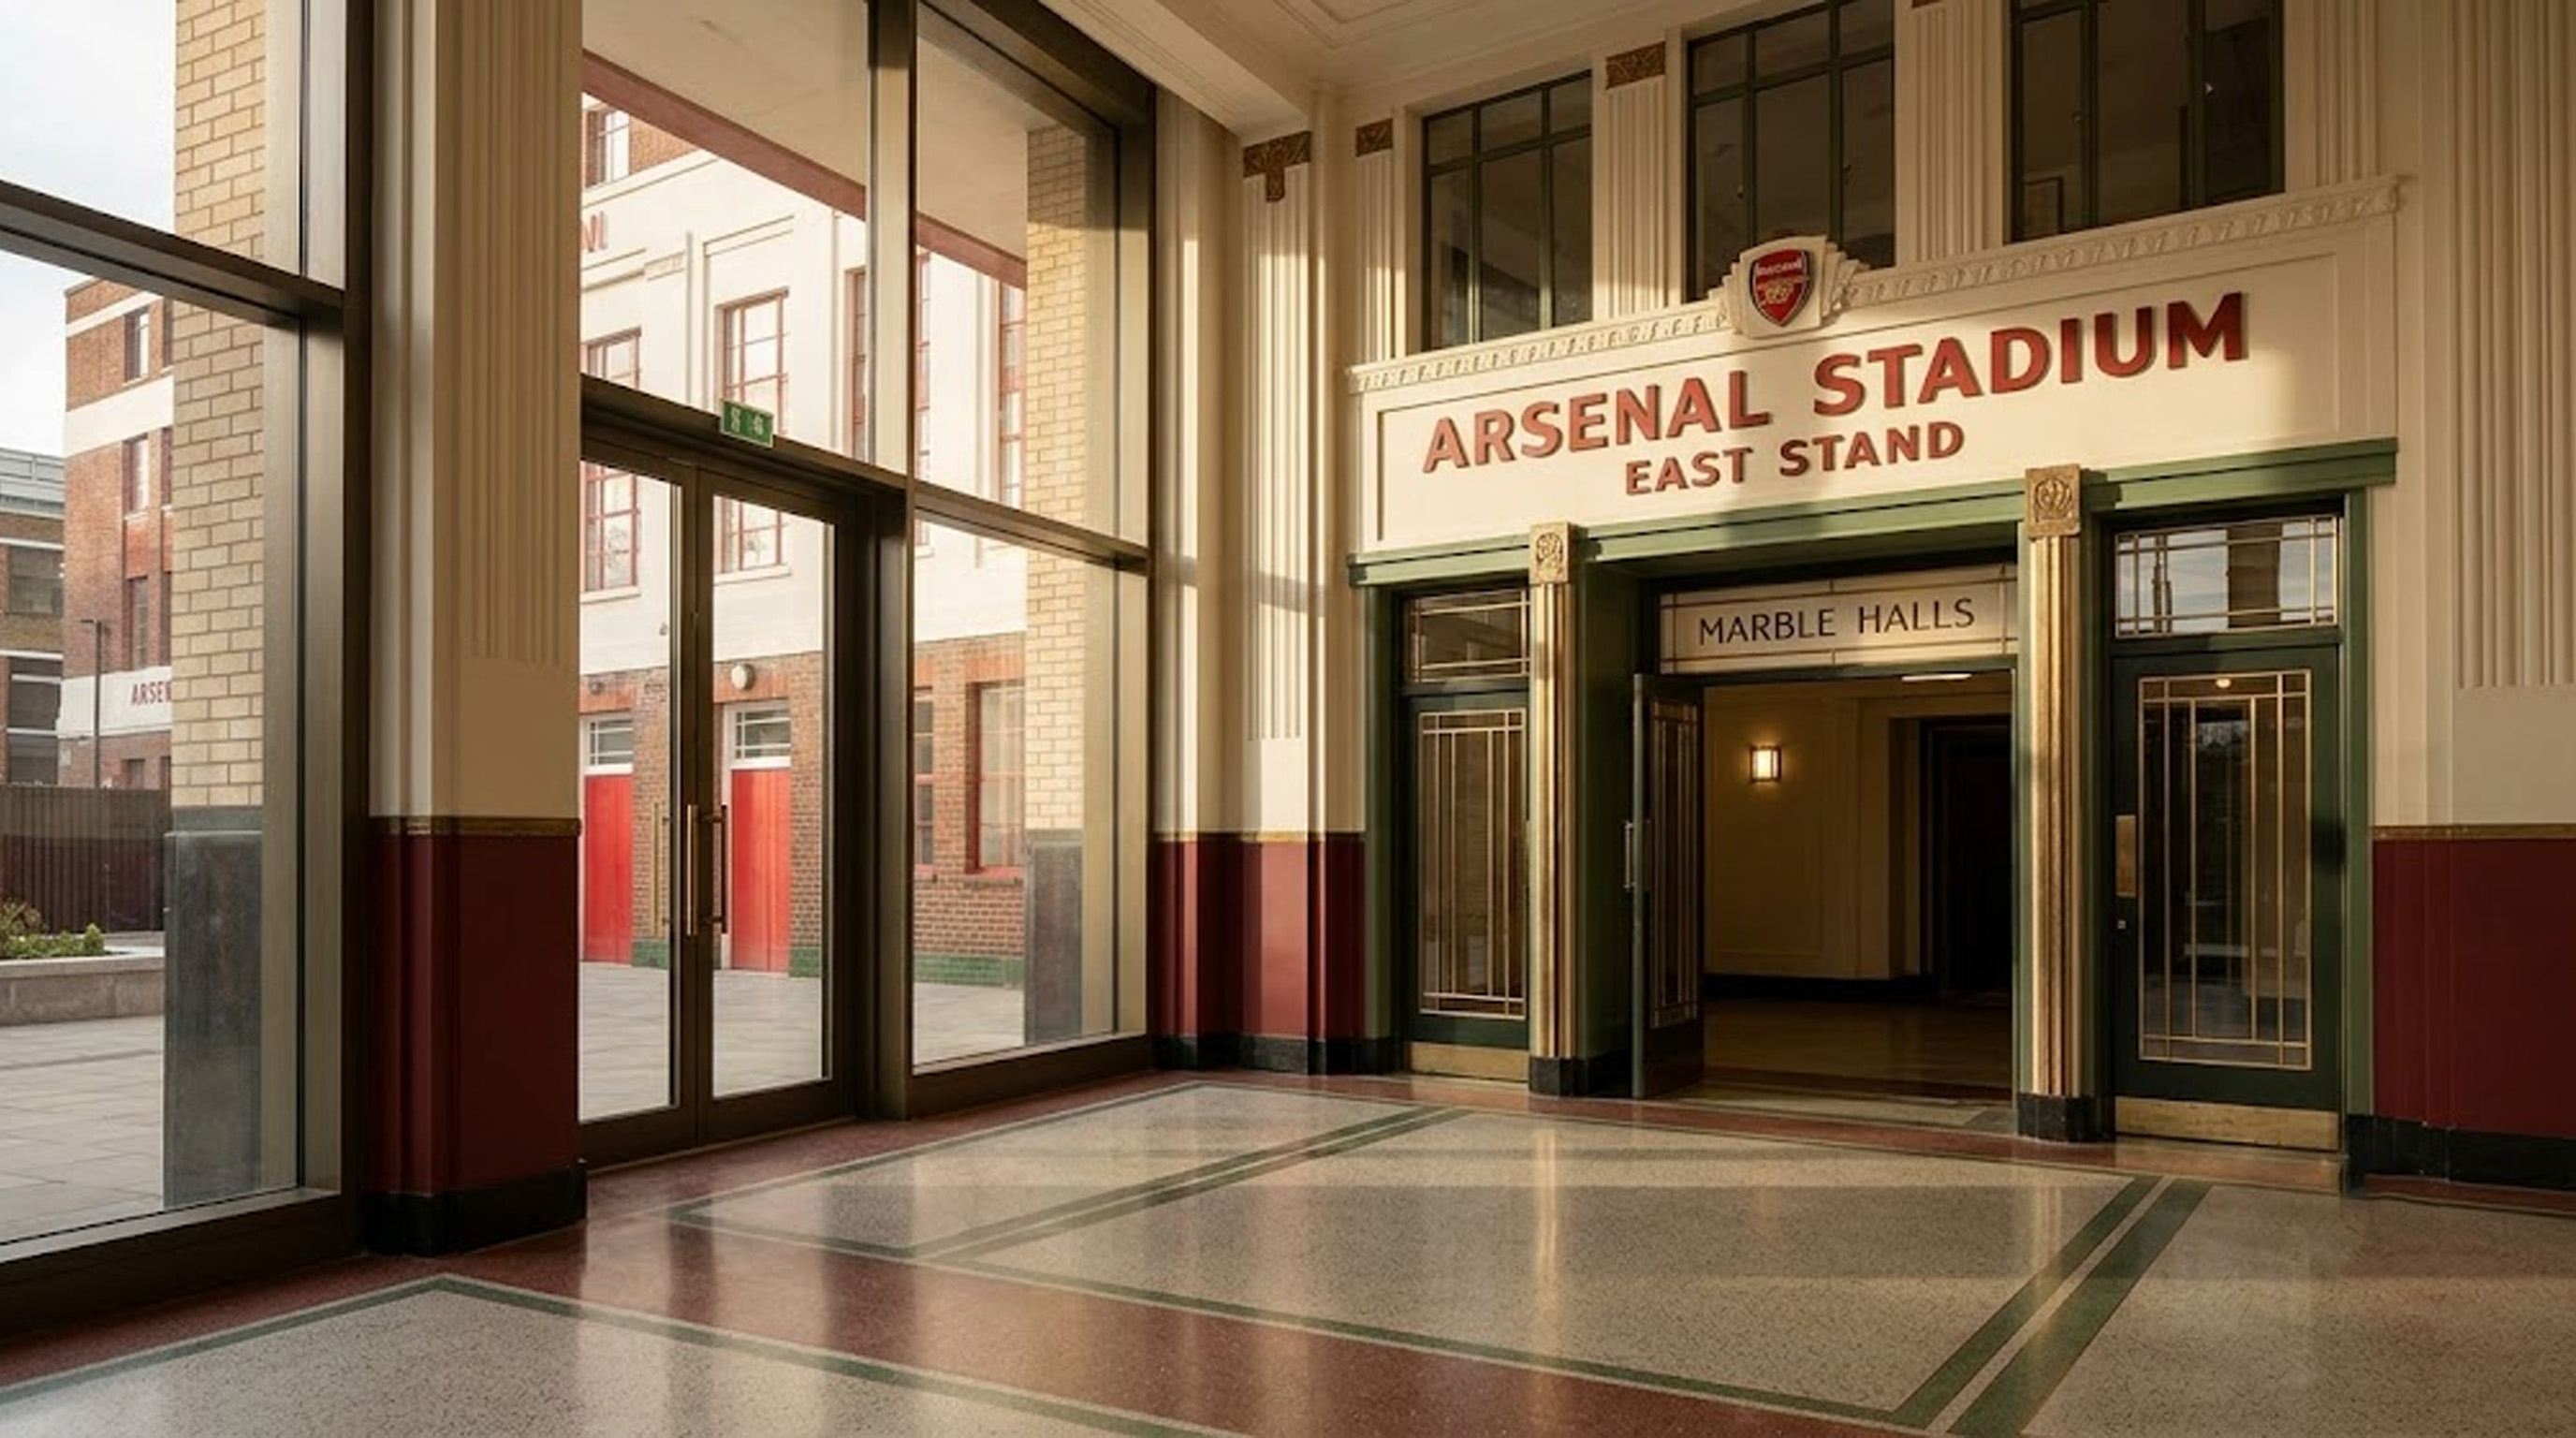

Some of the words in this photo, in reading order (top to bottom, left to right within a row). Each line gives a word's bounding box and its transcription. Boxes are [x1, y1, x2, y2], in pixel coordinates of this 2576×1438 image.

[1423, 371, 1772, 474] ARSENAL
[1814, 292, 2247, 417] STADIUM
[1626, 448, 1753, 495] EAST
[1779, 421, 1964, 477] STAND
[1698, 609, 1836, 646] MARBLE
[1858, 597, 1975, 634] HALLS
